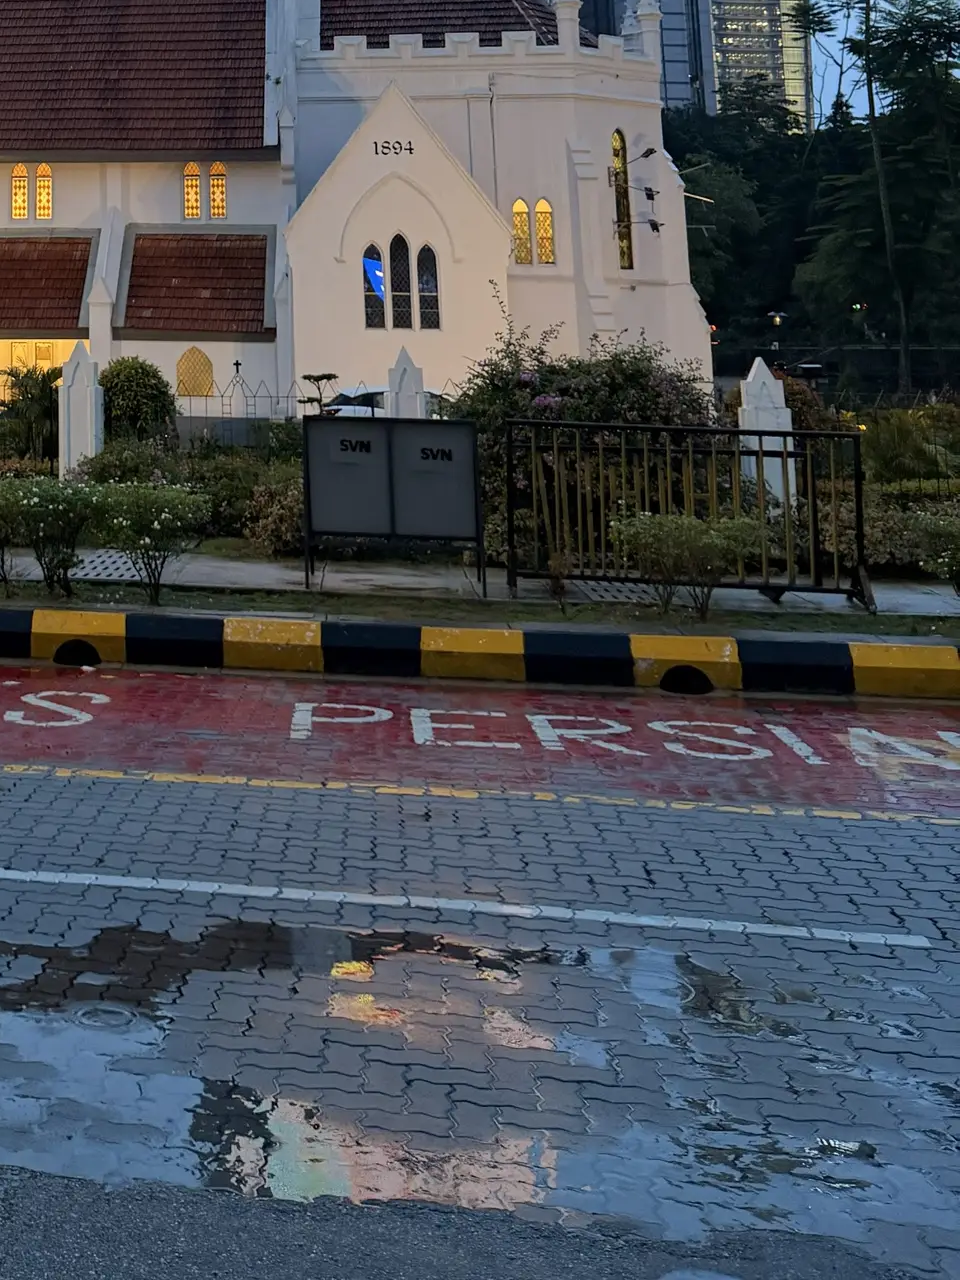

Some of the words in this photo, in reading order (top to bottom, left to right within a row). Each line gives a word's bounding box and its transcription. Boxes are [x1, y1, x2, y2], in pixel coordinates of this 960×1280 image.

[373, 140, 414, 155] 1894
[340, 439, 371, 453] SVN
[420, 448, 453, 461] SVN
